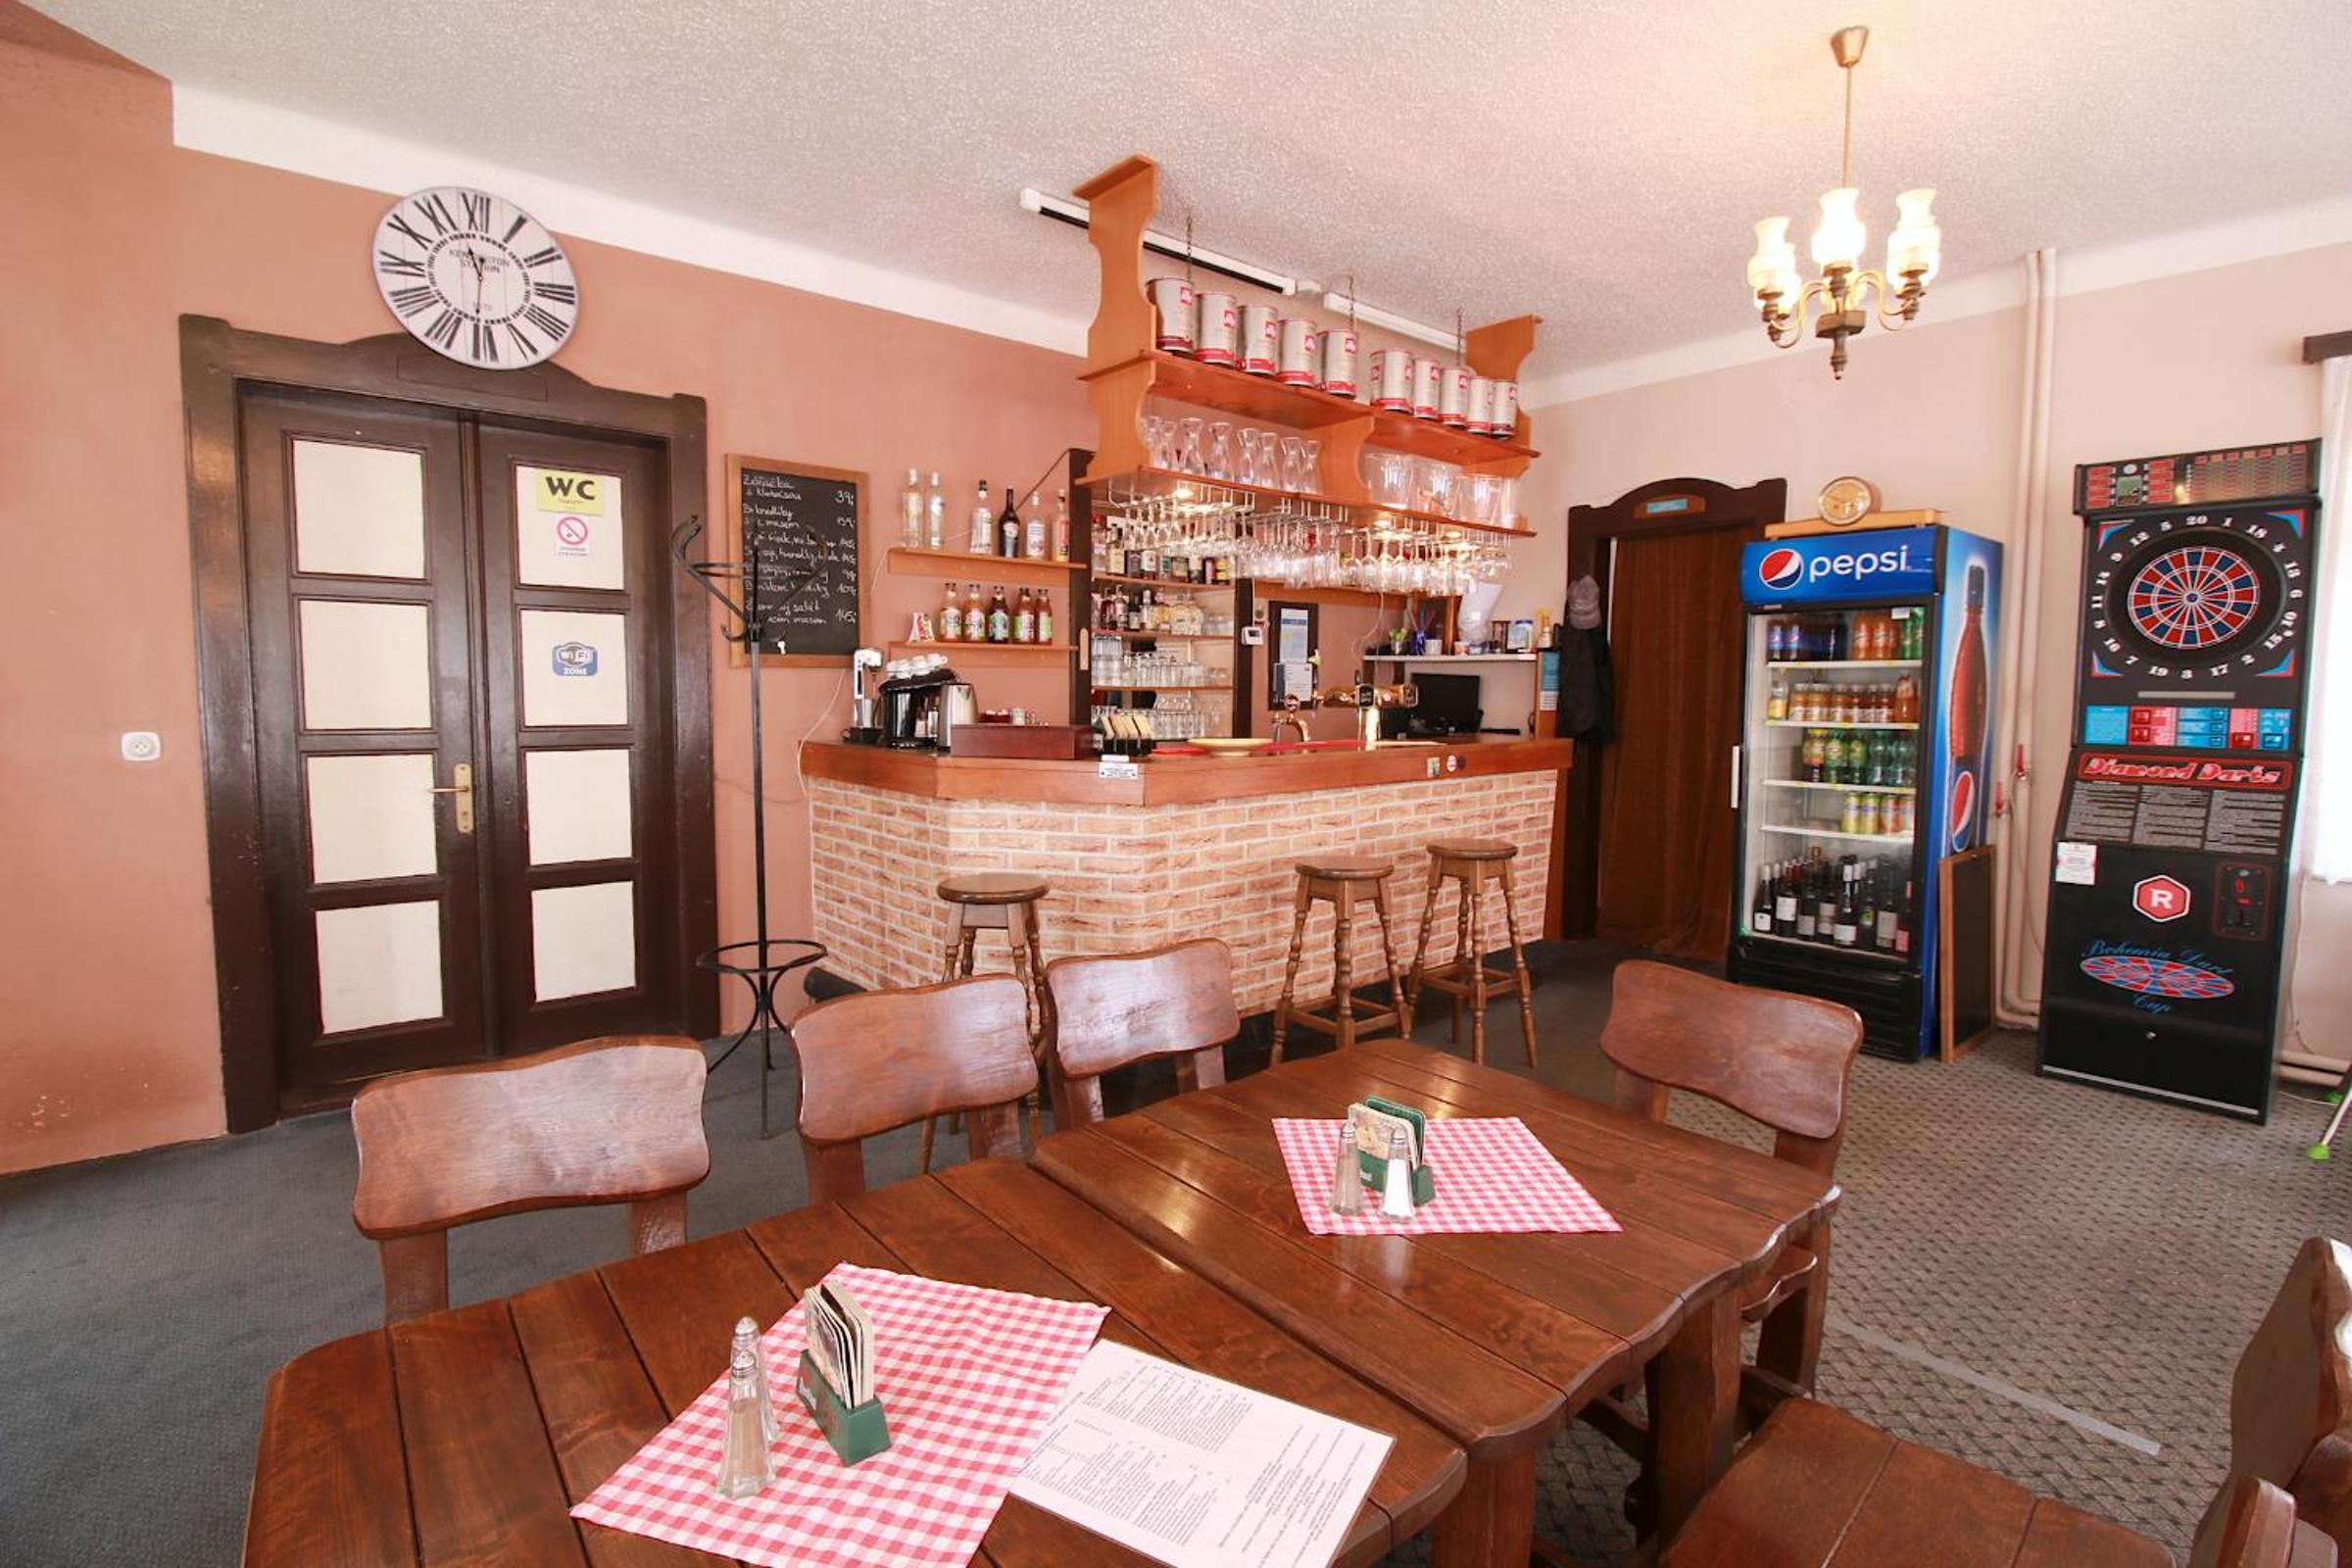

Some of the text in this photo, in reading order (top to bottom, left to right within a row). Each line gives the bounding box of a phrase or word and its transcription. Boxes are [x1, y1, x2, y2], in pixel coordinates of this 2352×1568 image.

[413, 193, 458, 235] XI
[462, 192, 491, 233] XII
[387, 214, 433, 250] X
[379, 250, 427, 277] IX
[523, 246, 564, 269] II
[533, 281, 576, 306] III
[471, 322, 500, 363] VI
[507, 322, 539, 361] V
[545, 475, 596, 501] WC
[2186, 514, 2209, 526] 20
[2222, 516, 2234, 528] 1
[2129, 531, 2151, 549] 12
[2245, 523, 2270, 540] 18
[1809, 545, 1909, 583] pepsi
[2110, 552, 2125, 564] 9
[2095, 570, 2111, 587] 14
[2091, 595, 2104, 610] 11
[2093, 618, 2107, 630] 8
[2280, 611, 2298, 628] 10
[2104, 637, 2123, 654] 16
[2263, 632, 2284, 651] 15
[2125, 655, 2140, 667] 7
[2240, 654, 2256, 666] 2
[2148, 664, 2170, 678] 19
[2210, 662, 2231, 678] 17
[2084, 758, 2281, 784] Diamond Darts
[2150, 888, 2173, 910] R
[2080, 940, 2172, 957] Bohemia
